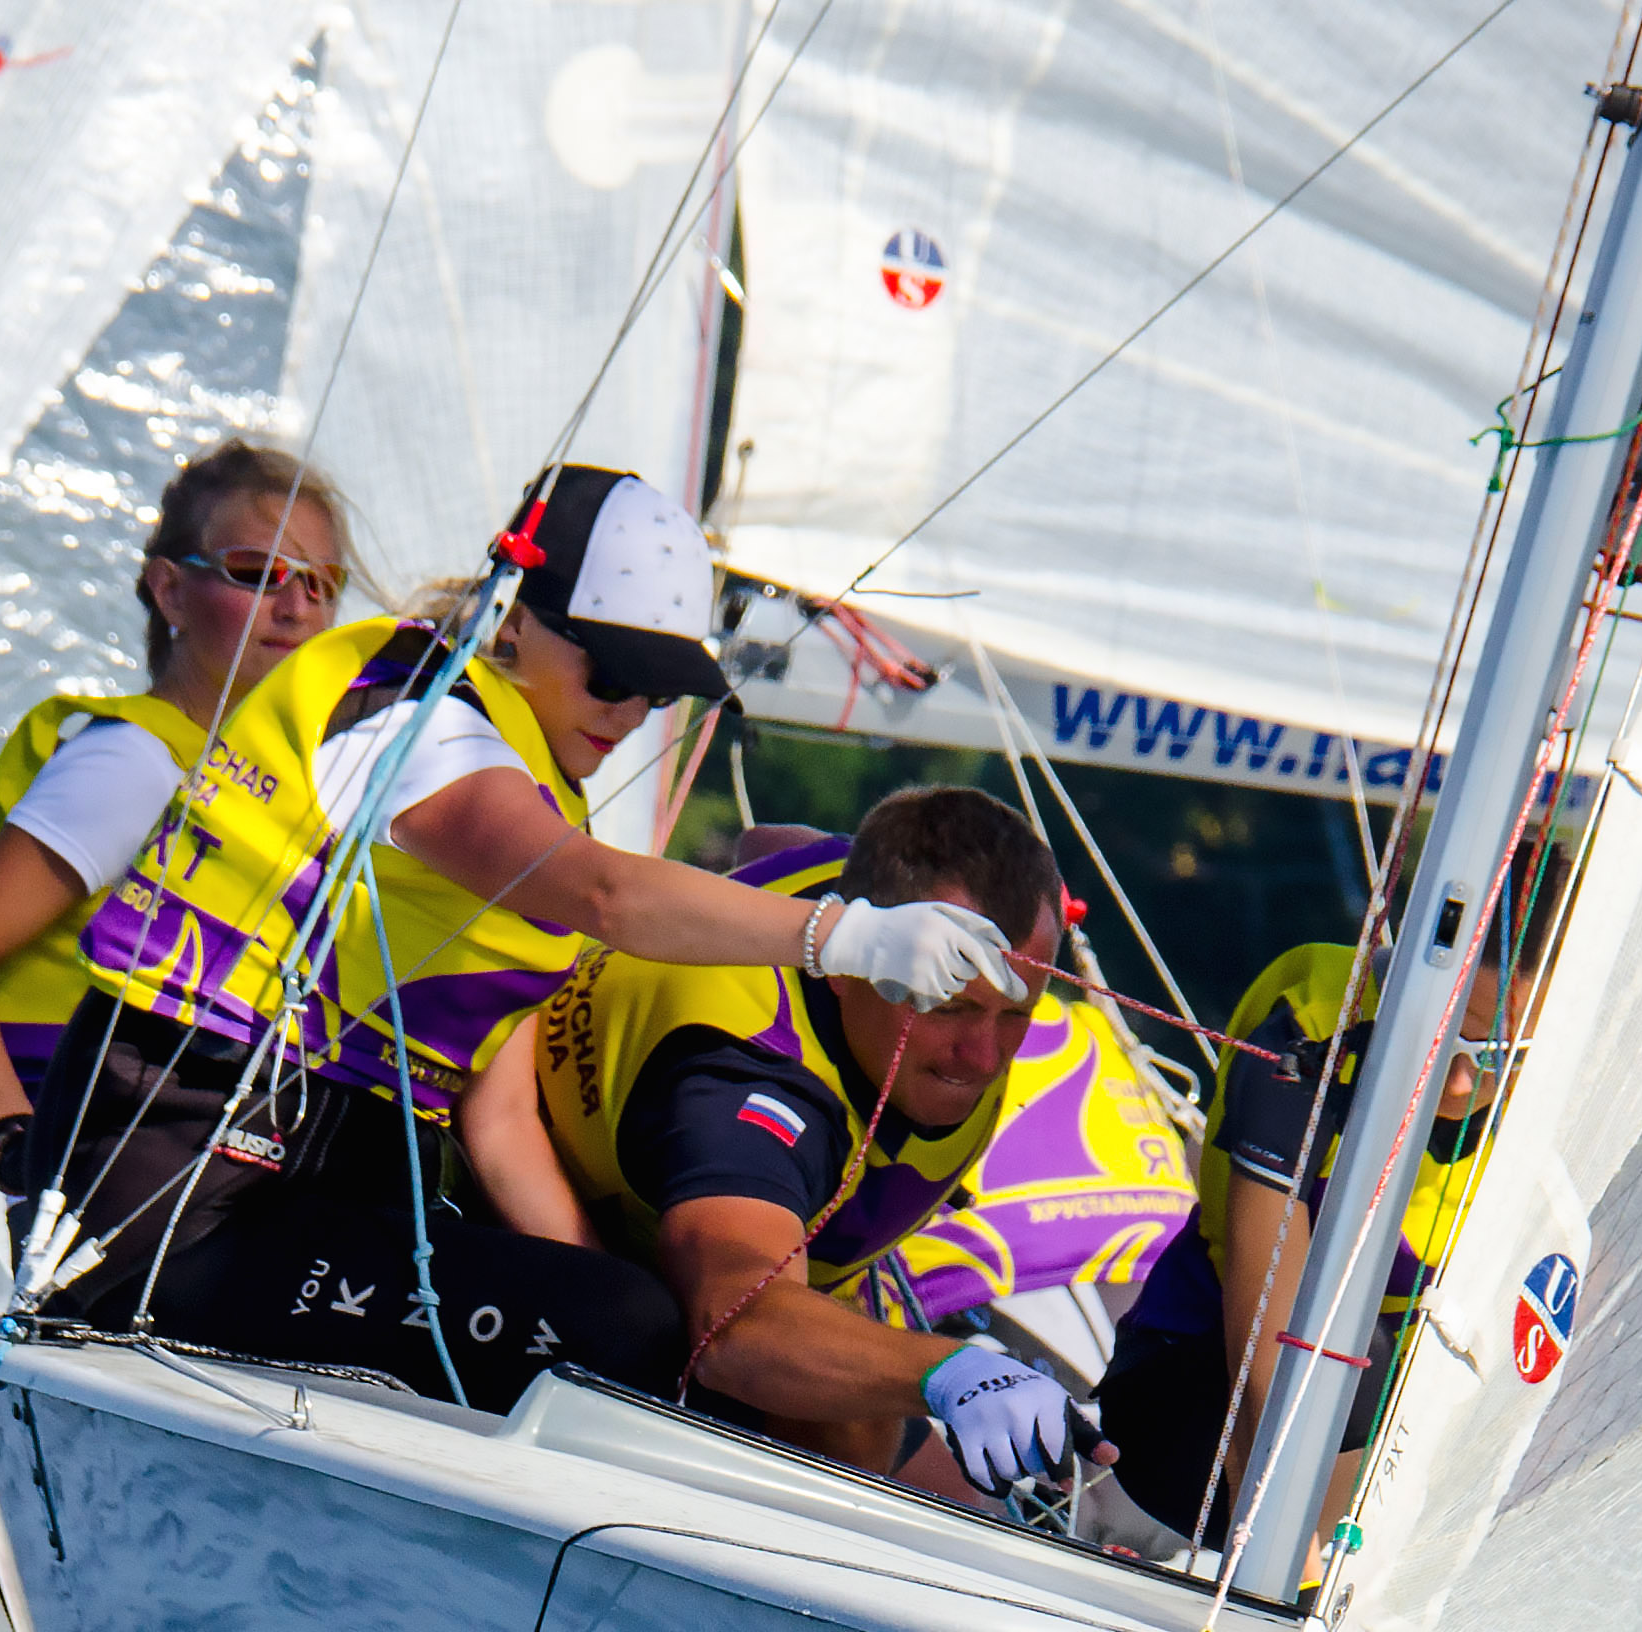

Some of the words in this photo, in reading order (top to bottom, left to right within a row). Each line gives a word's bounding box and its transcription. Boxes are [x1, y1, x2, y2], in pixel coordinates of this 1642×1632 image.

[290, 1258, 330, 1315] YOU
[1545, 1255, 1578, 1316] U
[1516, 1324, 1546, 1374] S
